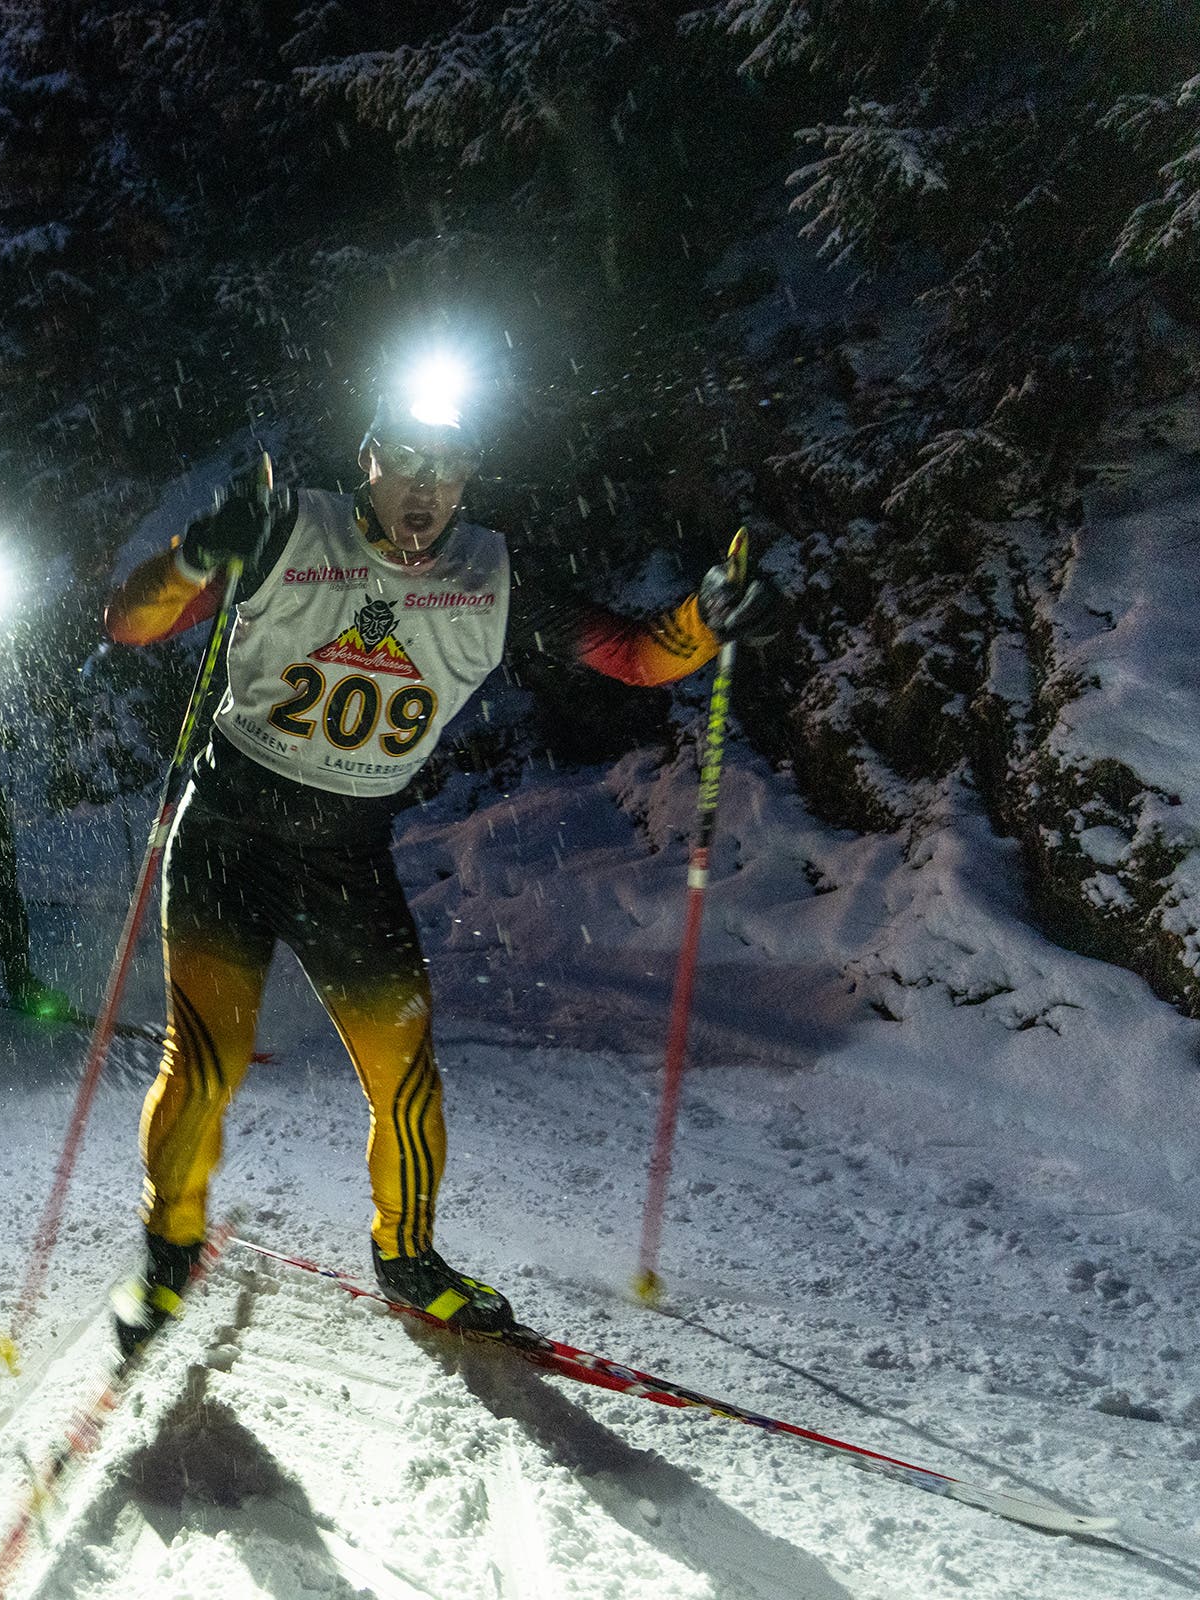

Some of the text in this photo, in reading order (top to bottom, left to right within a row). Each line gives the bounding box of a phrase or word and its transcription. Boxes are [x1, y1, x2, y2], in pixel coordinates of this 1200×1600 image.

[284, 566, 368, 582] Schilthorn
[404, 592, 495, 607] Schilthorn
[267, 662, 438, 758] 209
